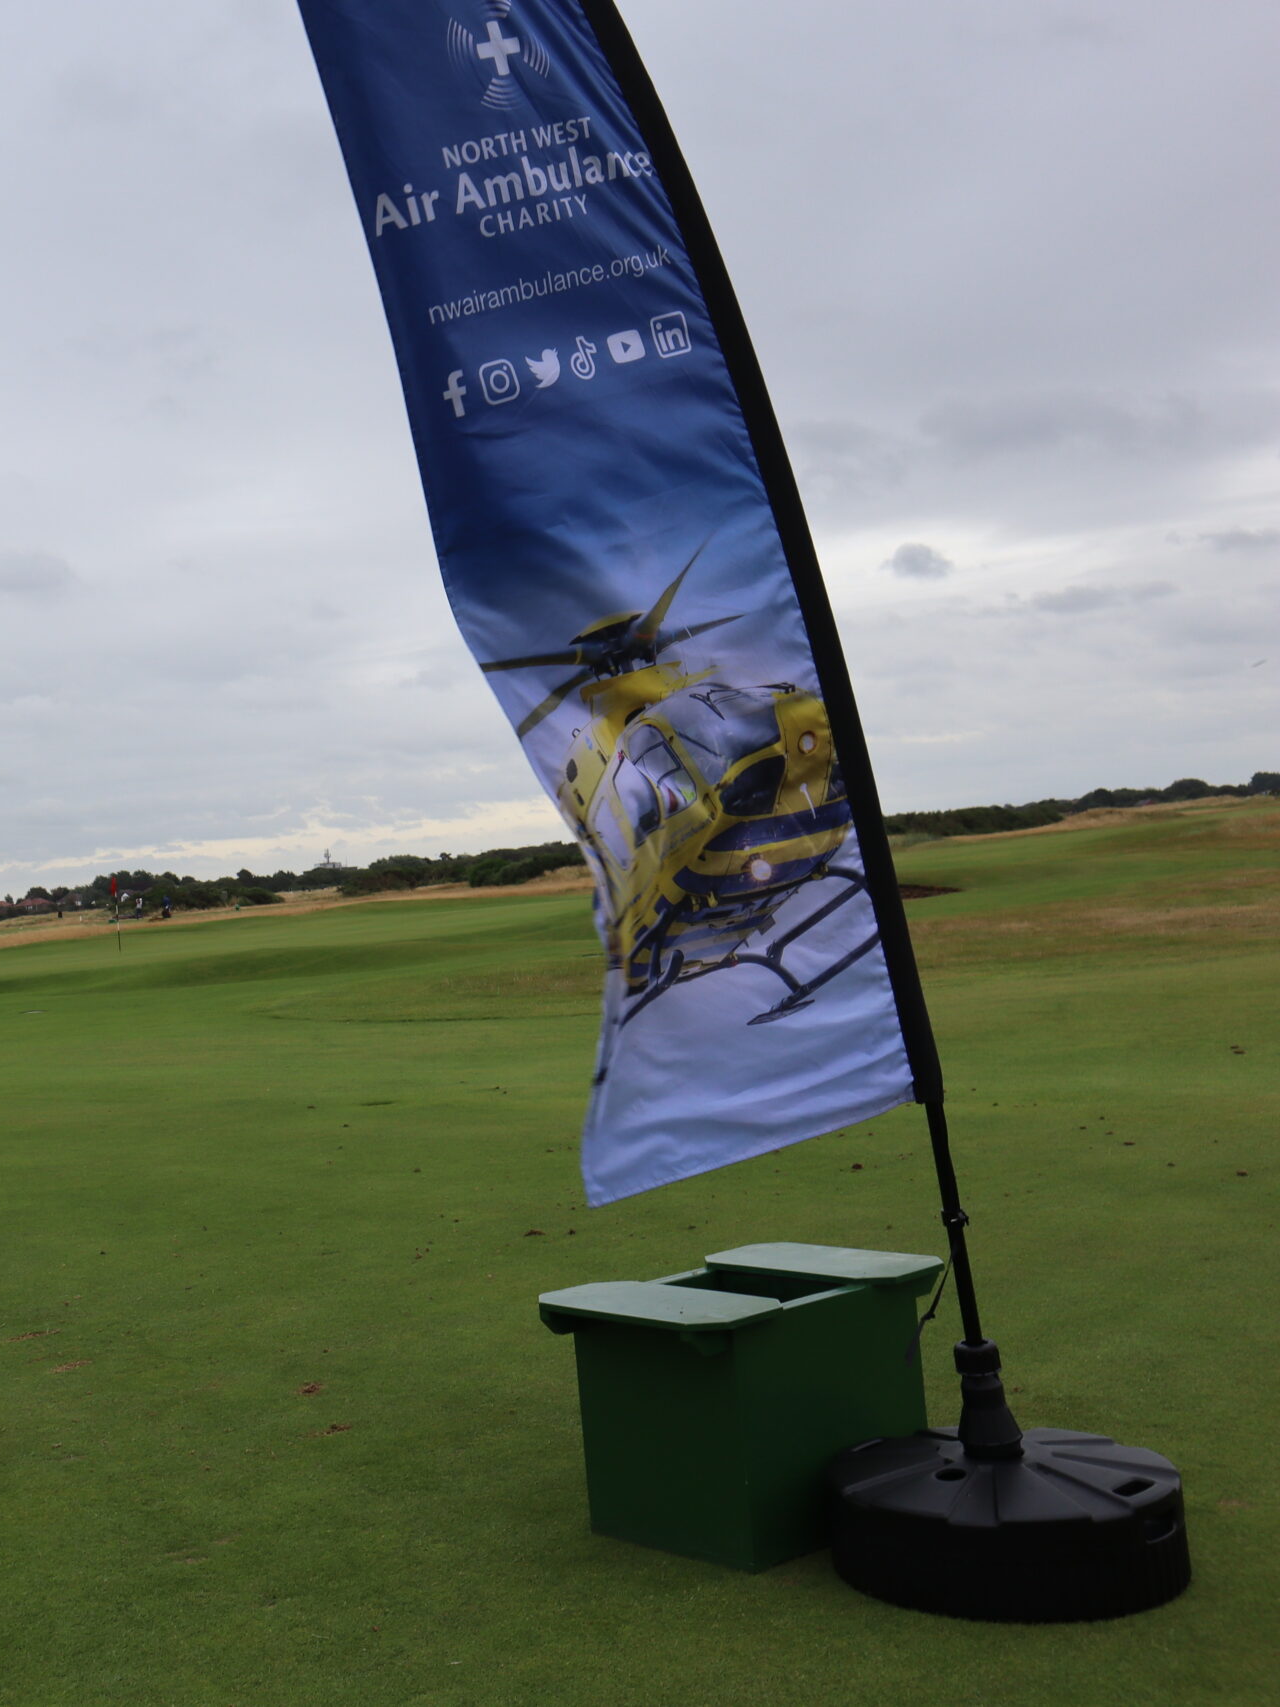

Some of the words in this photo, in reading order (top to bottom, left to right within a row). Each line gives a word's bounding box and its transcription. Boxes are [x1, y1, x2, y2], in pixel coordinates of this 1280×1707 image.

[442, 130, 527, 168] NORTH
[532, 117, 590, 148] WEST
[376, 183, 439, 237] Air
[456, 146, 654, 215] Ambulance
[479, 193, 588, 237] CHARITY
[428, 244, 671, 325] nwairambulance.org.uk
